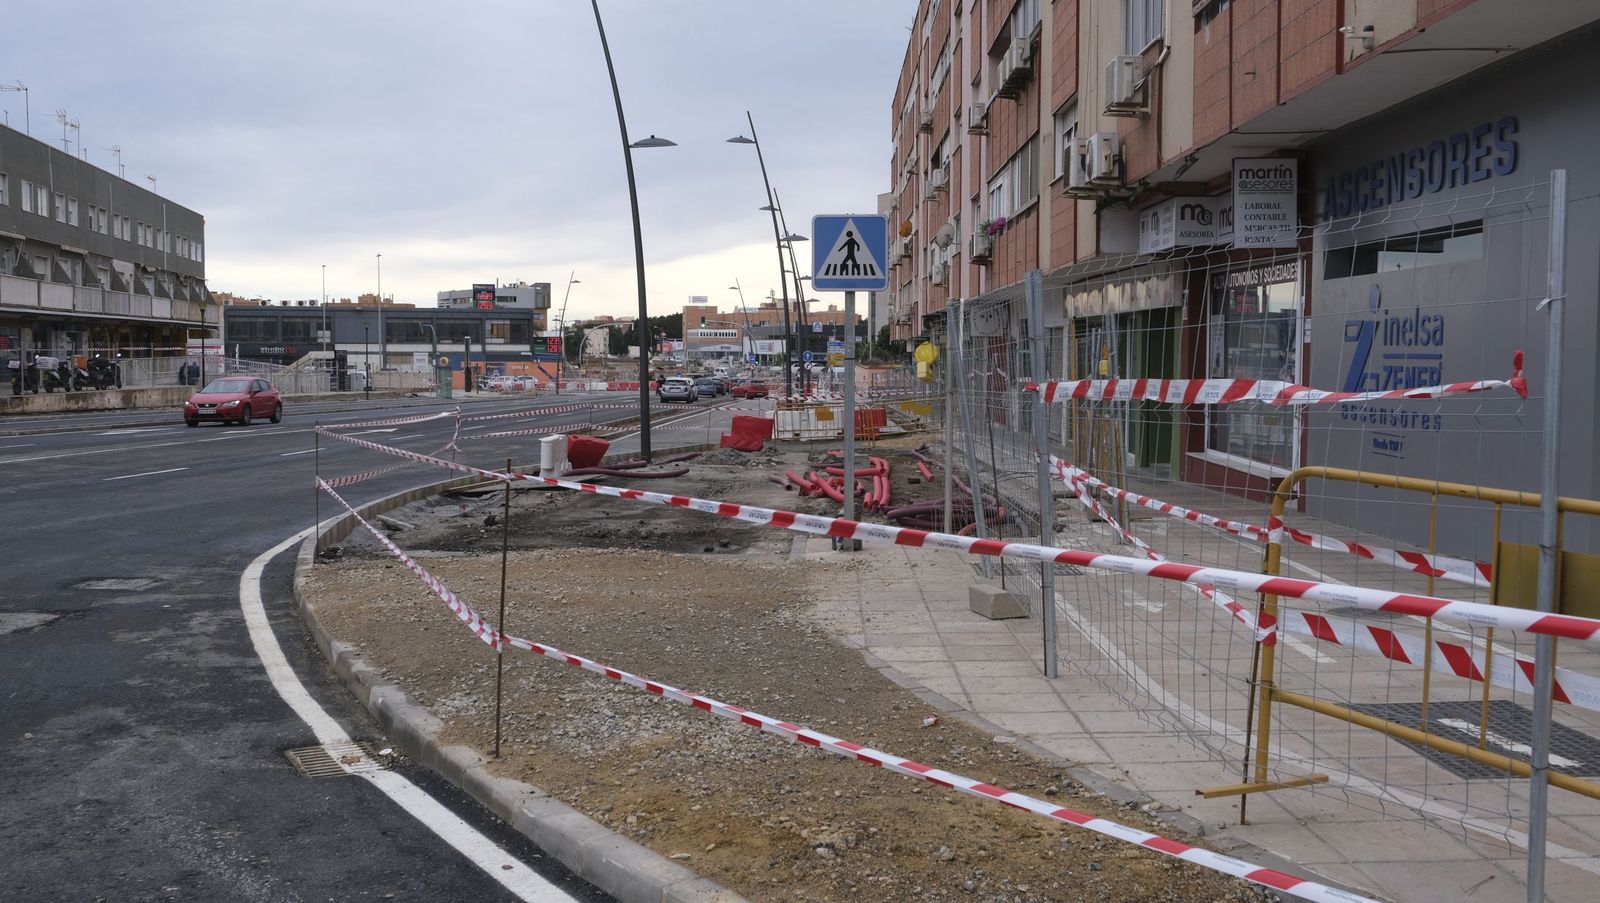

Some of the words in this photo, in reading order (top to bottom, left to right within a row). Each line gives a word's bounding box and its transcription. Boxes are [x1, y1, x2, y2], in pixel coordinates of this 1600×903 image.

[1239, 164, 1293, 179] martín
[1324, 116, 1520, 220] ASCENSORES
[1244, 202, 1282, 210] LABORAL
[1244, 213, 1288, 221] CONTABLE
[1179, 229, 1214, 239] ASESORÍA
[1259, 268, 1264, 284] Y
[1264, 261, 1298, 283] SOCIEDADES
[1383, 306, 1445, 347] inelsa
[1341, 403, 1442, 432] ascensores
